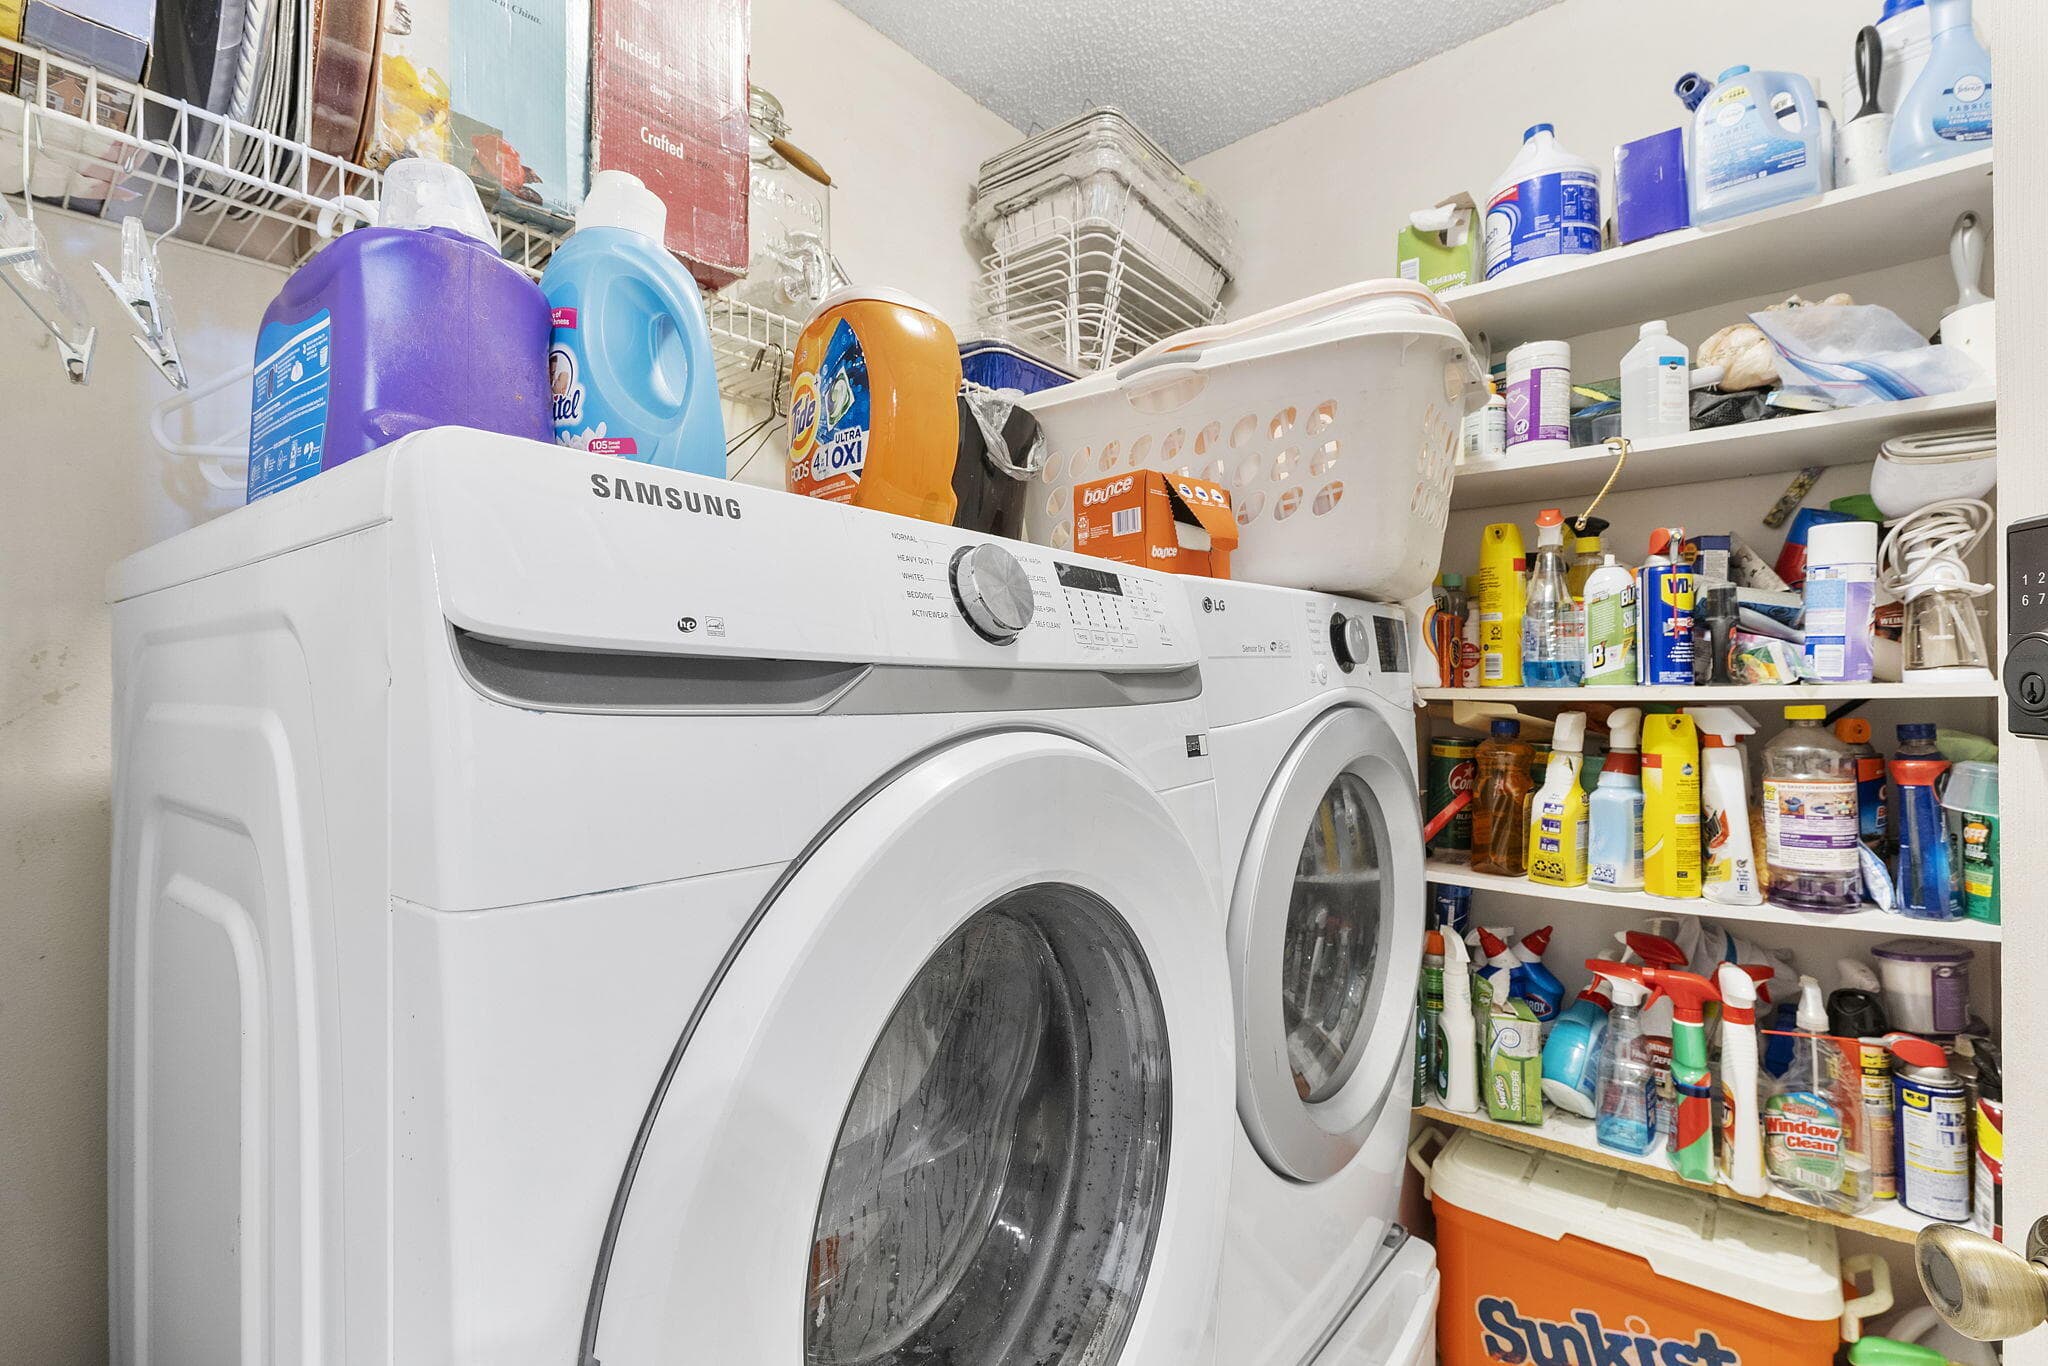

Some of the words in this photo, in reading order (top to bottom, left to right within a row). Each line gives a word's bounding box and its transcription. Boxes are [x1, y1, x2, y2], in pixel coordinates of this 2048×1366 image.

[511, 4, 541, 25] China.
[615, 30, 660, 69] Incised
[640, 126, 684, 159] Crafted
[791, 394, 817, 448] Tide
[835, 428, 862, 444] ULTRA
[591, 440, 608, 450] 105
[831, 440, 862, 469] OXI
[591, 474, 742, 519] SAMSUNG
[1083, 476, 1134, 507] bounce
[891, 532, 918, 543] NORMAL
[897, 553, 917, 561] HEAVY
[917, 557, 934, 566] DUTY
[1151, 545, 1178, 558] bounce
[902, 571, 925, 582] WHITES
[2022, 574, 2028, 586] 1
[2038, 571, 2046, 584] 2
[906, 590, 934, 600] BEDDING
[2021, 594, 2029, 606] 6
[2038, 592, 2046, 605] 7
[1213, 599, 1226, 611] LG
[911, 609, 949, 619] ACTIVEWEAR
[1242, 644, 1257, 653] Sensor
[1257, 645, 1266, 653] Dry
[1510, 1070, 1520, 1111] SWEEPER
[1766, 1117, 1840, 1139] Window
[1786, 1136, 1836, 1153] Clean
[1478, 1296, 1739, 1366] Sunkist
